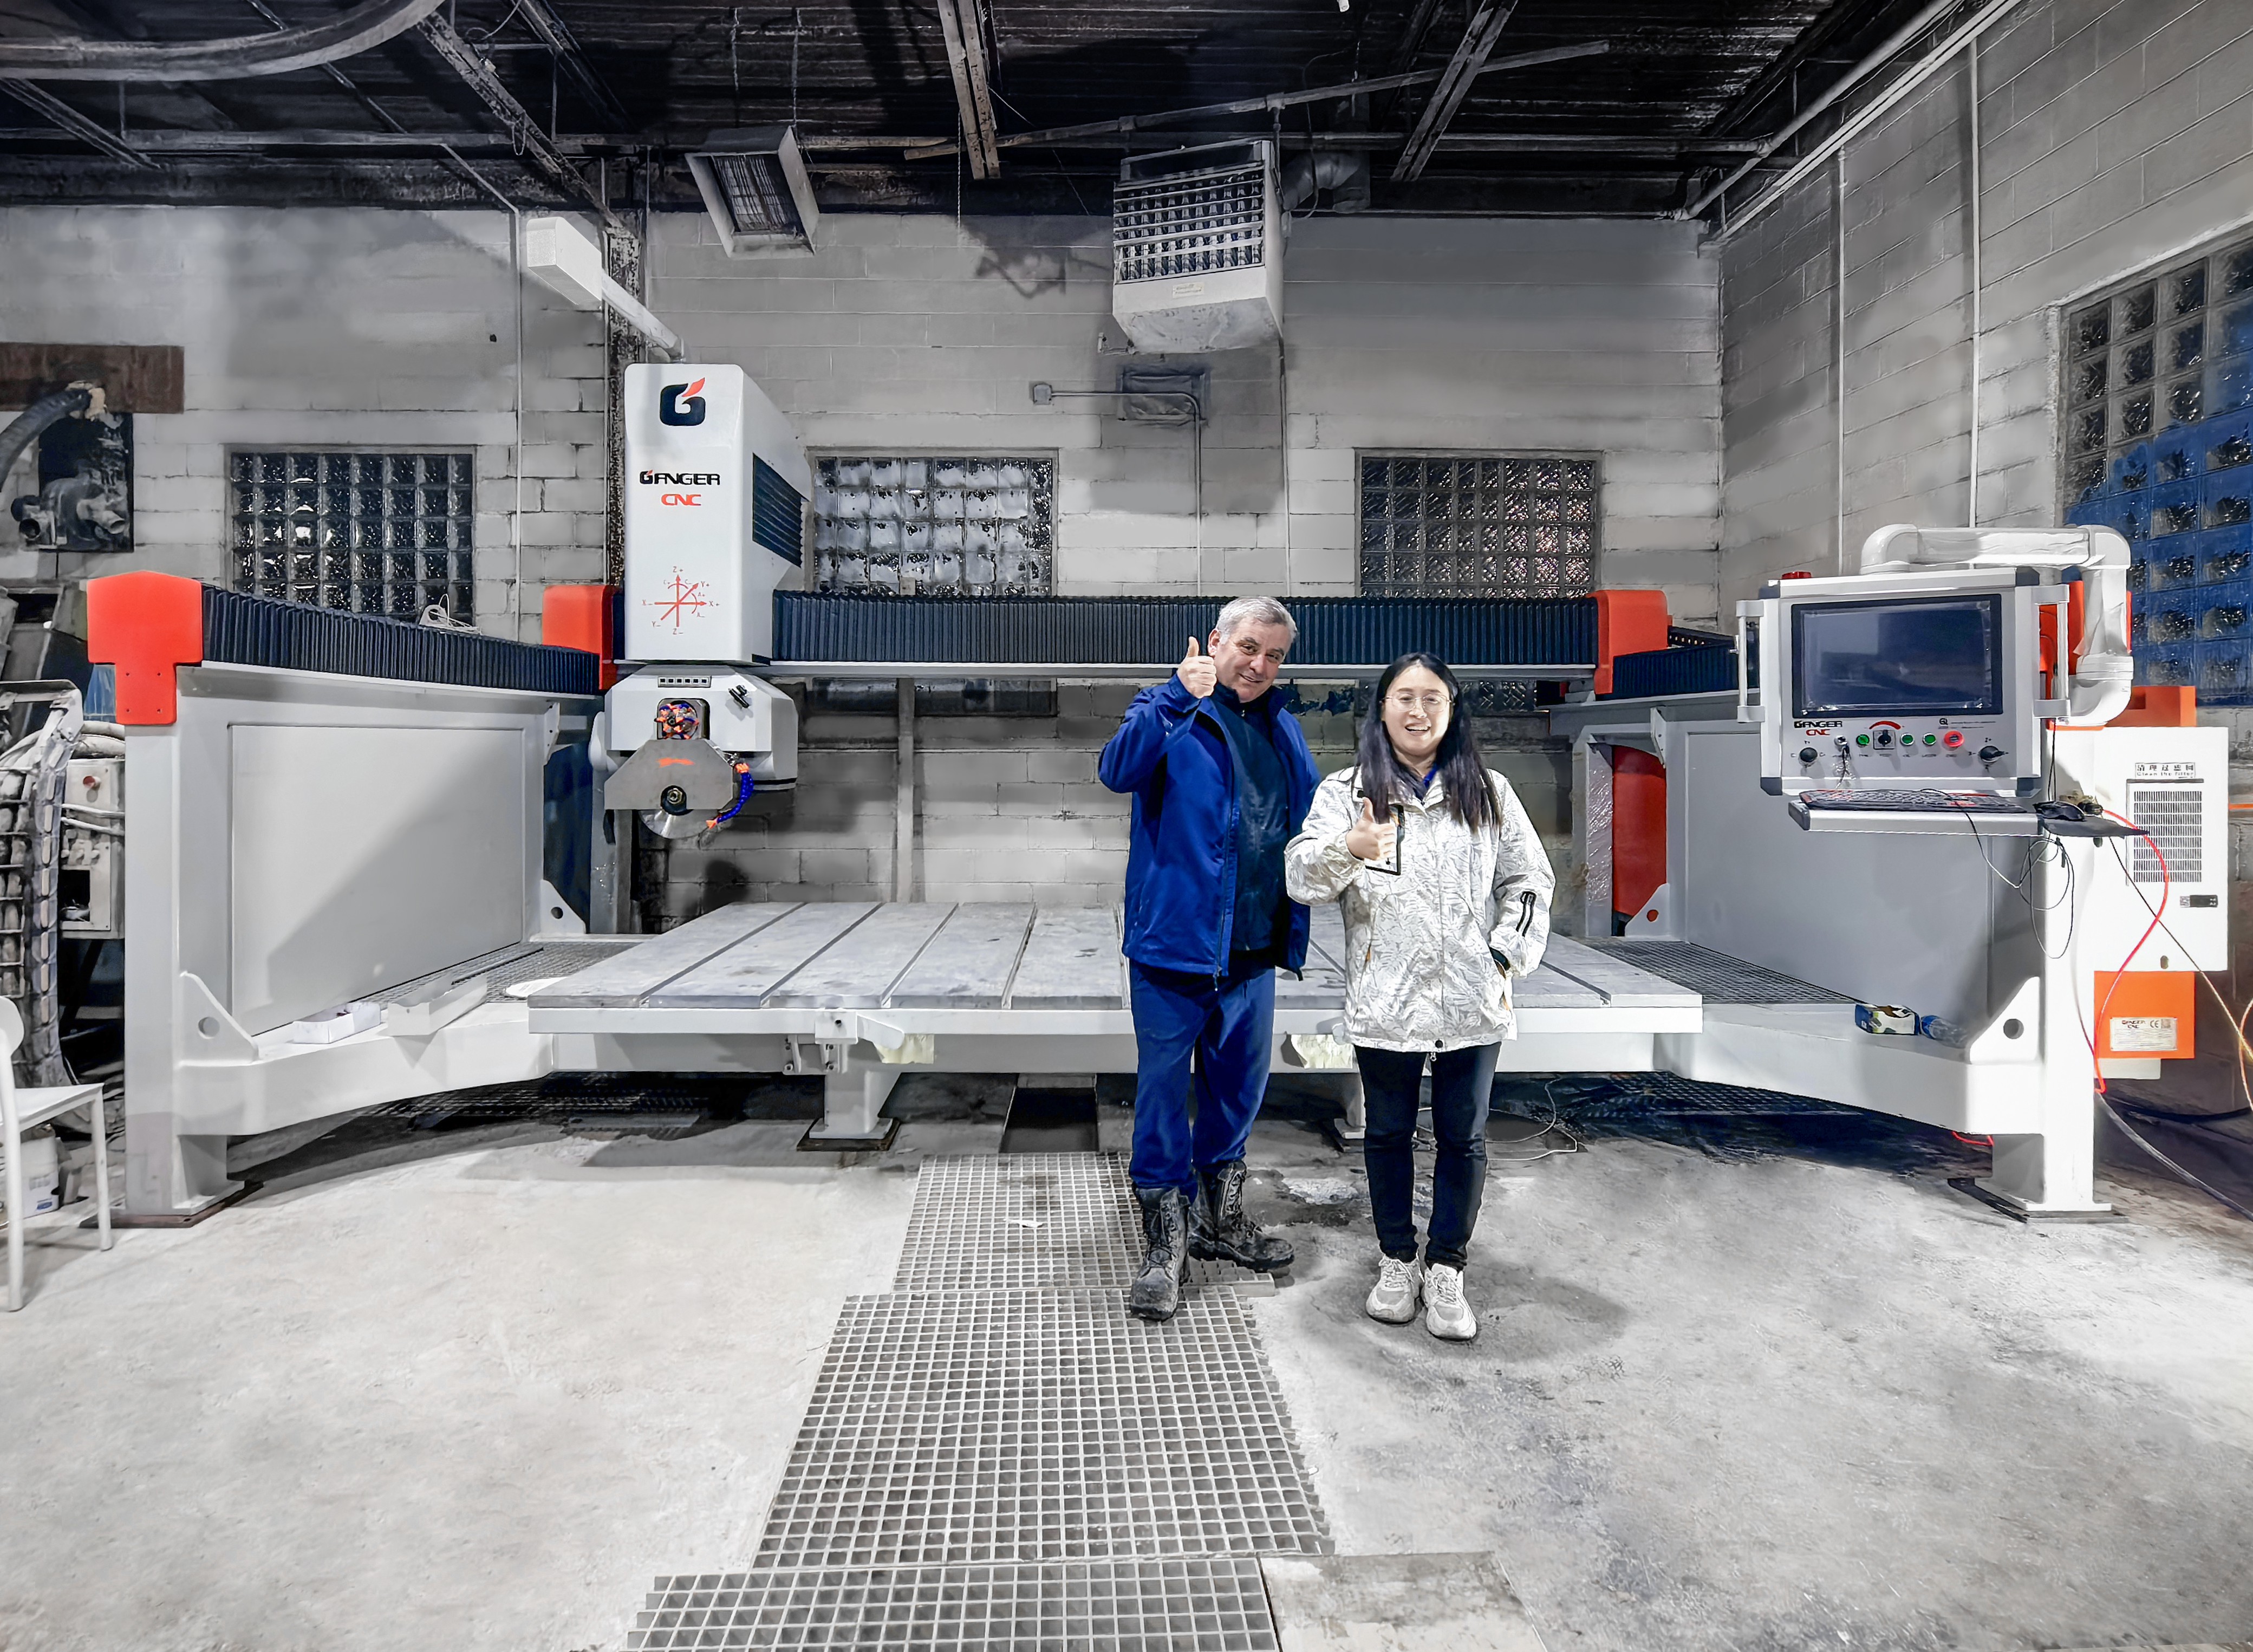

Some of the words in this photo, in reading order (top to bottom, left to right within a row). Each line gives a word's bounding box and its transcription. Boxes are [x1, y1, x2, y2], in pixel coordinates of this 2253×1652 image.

[640, 470, 720, 485] GANGER
[661, 493, 701, 506] CNC
[2150, 1020, 2160, 1028] CE
